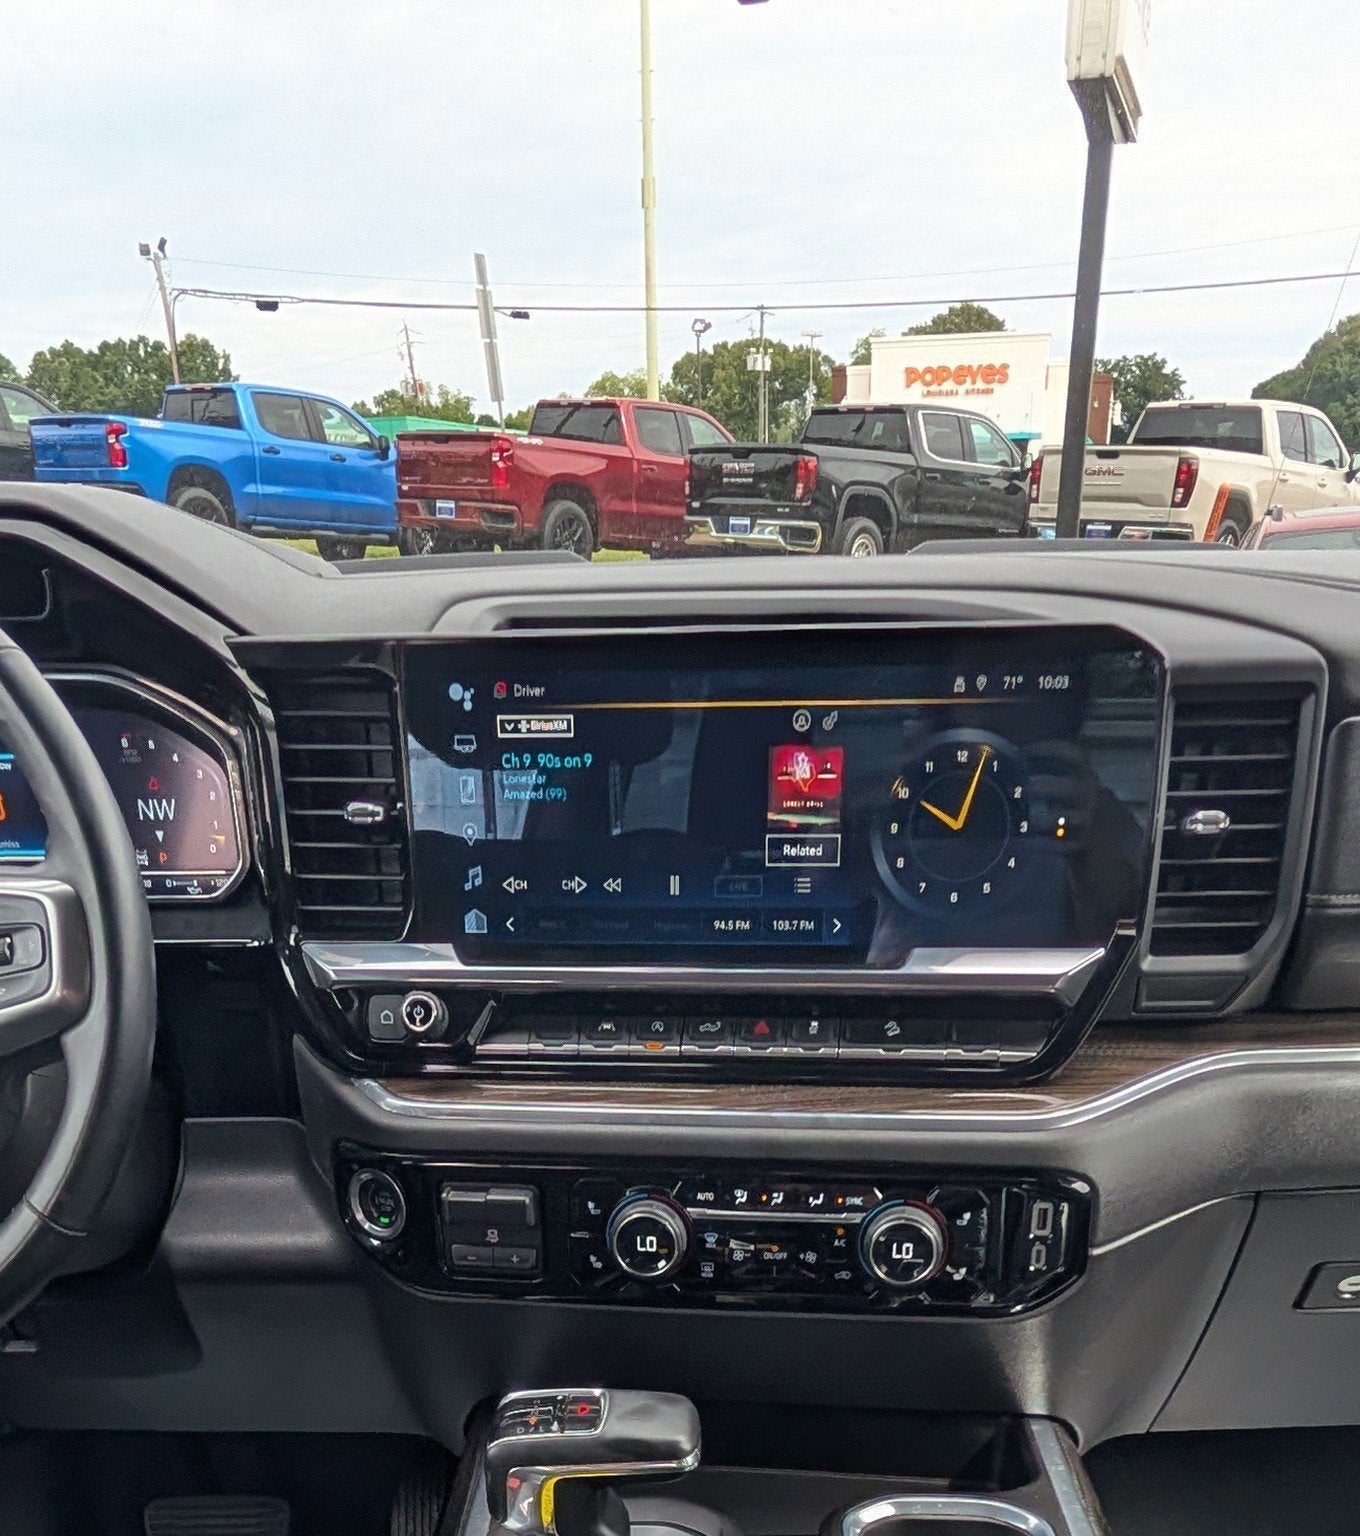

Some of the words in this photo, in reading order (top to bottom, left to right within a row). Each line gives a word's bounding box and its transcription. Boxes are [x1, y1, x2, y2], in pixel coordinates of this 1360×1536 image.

[904, 363, 1010, 388] POPEYES
[1084, 465, 1125, 477] GMC
[513, 683, 546, 698] Driver
[501, 754, 520, 769] Ch
[522, 753, 532, 769] 9
[537, 754, 562, 769] 90s
[564, 757, 582, 769] on
[583, 753, 593, 769] 9
[956, 750, 969, 763] 12
[992, 760, 999, 772] 1
[504, 788, 543, 800] Amazed
[545, 788, 568, 801] (99)
[137, 798, 176, 821] NW
[1019, 821, 1028, 833] 3
[209, 843, 217, 853] 0
[783, 844, 824, 857] Related
[1007, 856, 1016, 868] 4
[514, 879, 528, 890] CH
[561, 879, 575, 890] CH
[918, 882, 927, 893] 7
[735, 920, 750, 930] FM
[799, 920, 815, 931] FM
[696, 1191, 715, 1202] AUTO
[636, 1236, 658, 1252] LO
[891, 1243, 914, 1260] LO
